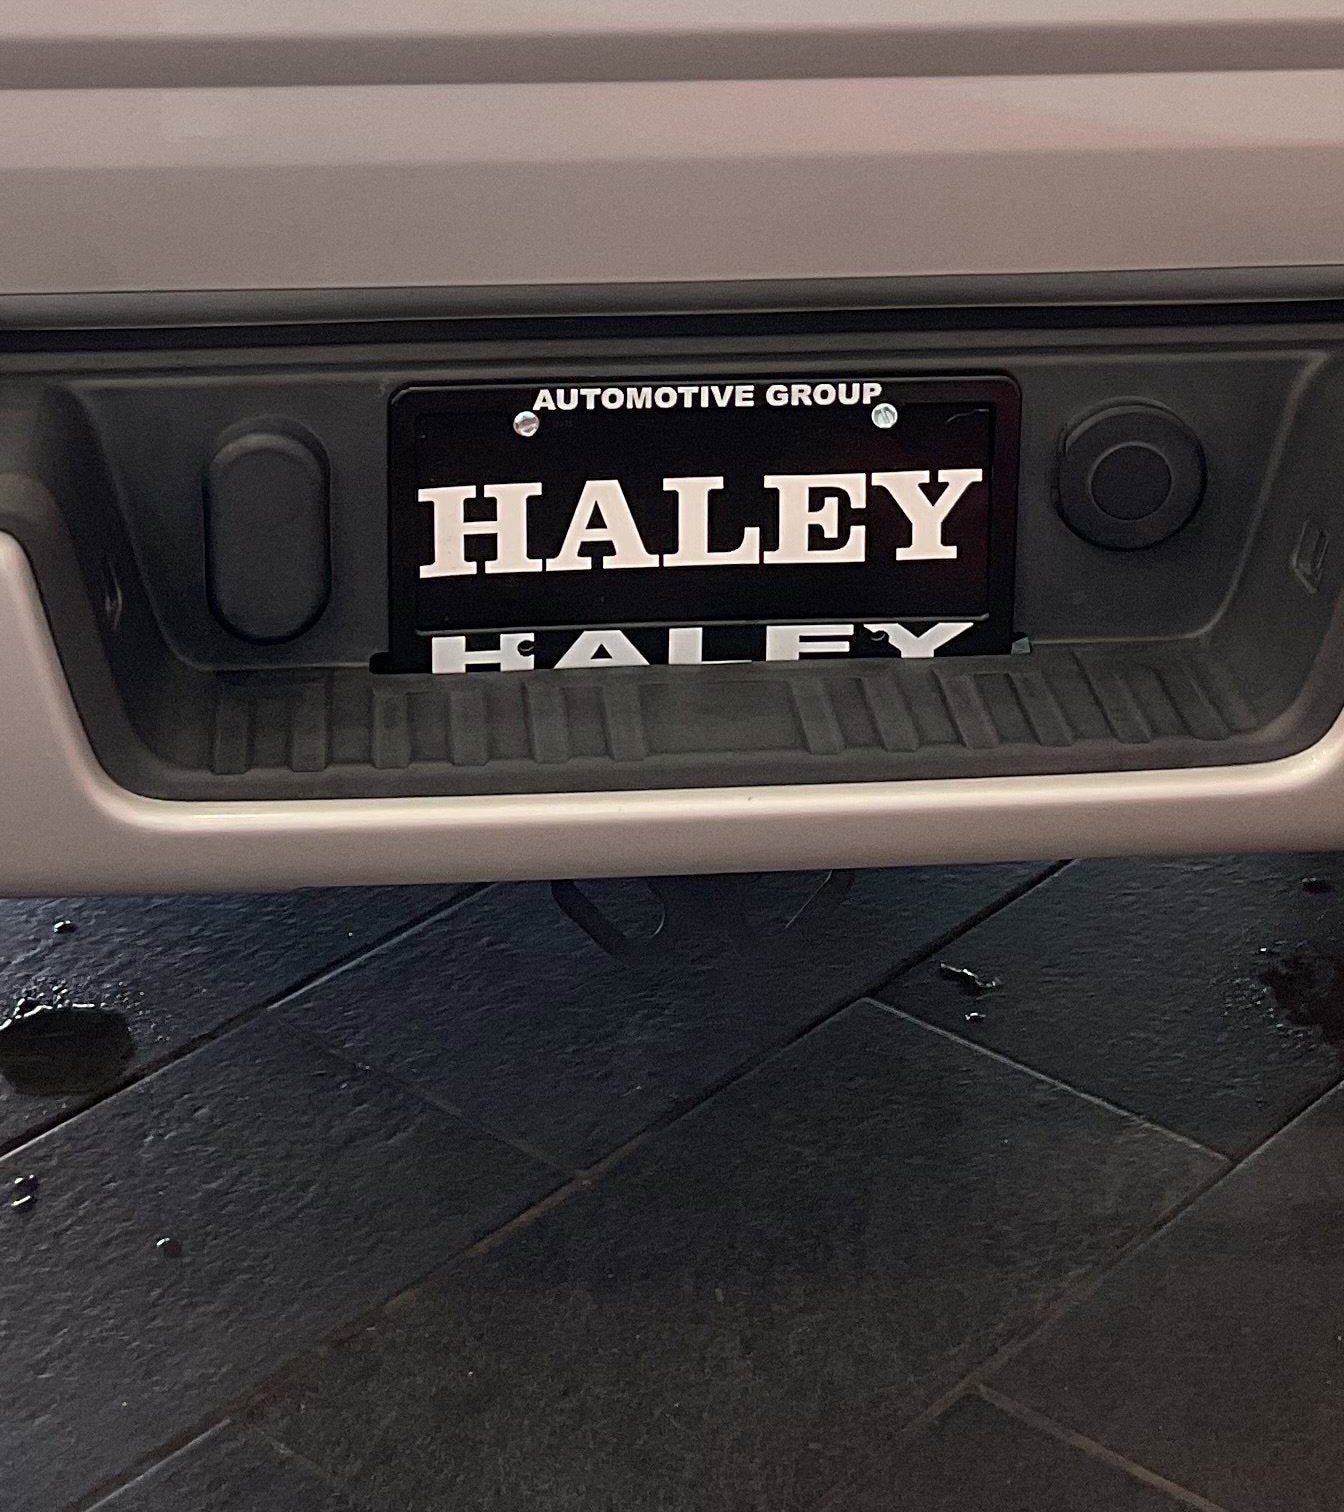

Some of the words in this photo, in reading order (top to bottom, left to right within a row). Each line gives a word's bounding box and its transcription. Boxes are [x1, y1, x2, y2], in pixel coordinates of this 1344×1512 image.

[533, 385, 754, 411] AUTOMOTIVE
[765, 383, 882, 406] GROUP
[418, 469, 983, 578] HALEY
